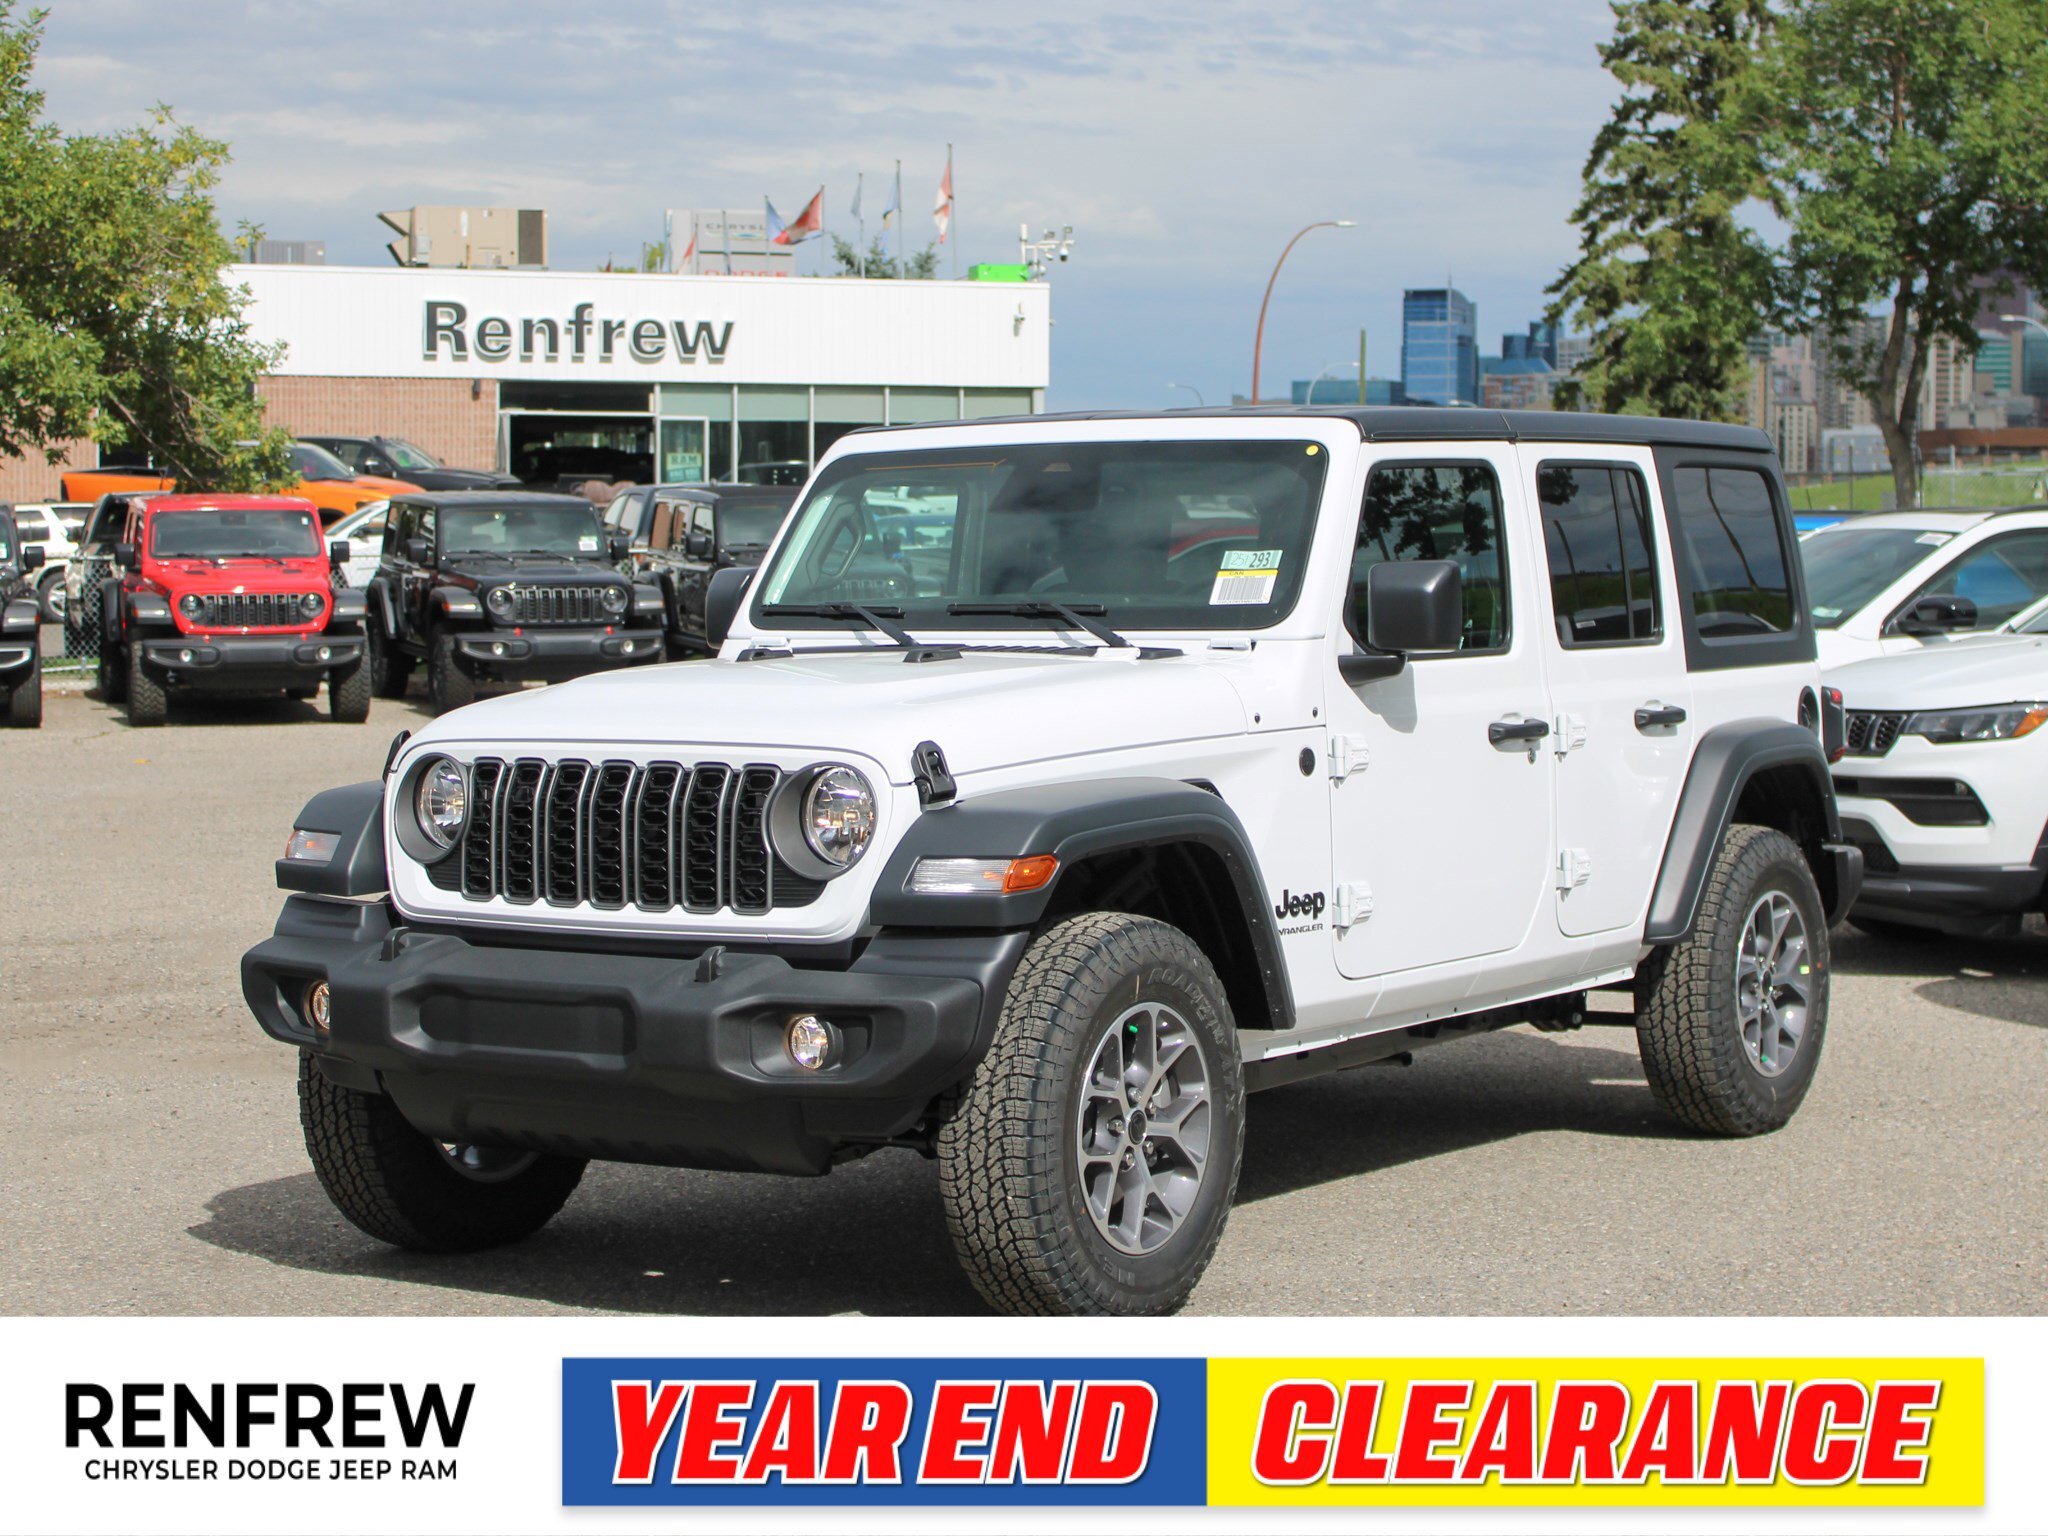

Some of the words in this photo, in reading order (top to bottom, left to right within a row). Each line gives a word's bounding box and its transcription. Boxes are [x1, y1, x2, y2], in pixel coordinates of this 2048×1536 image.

[705, 222, 768, 231] CHRYSL
[425, 301, 734, 361] Renfrew
[1248, 551, 1272, 568] 293
[1275, 889, 1325, 920] Jeep
